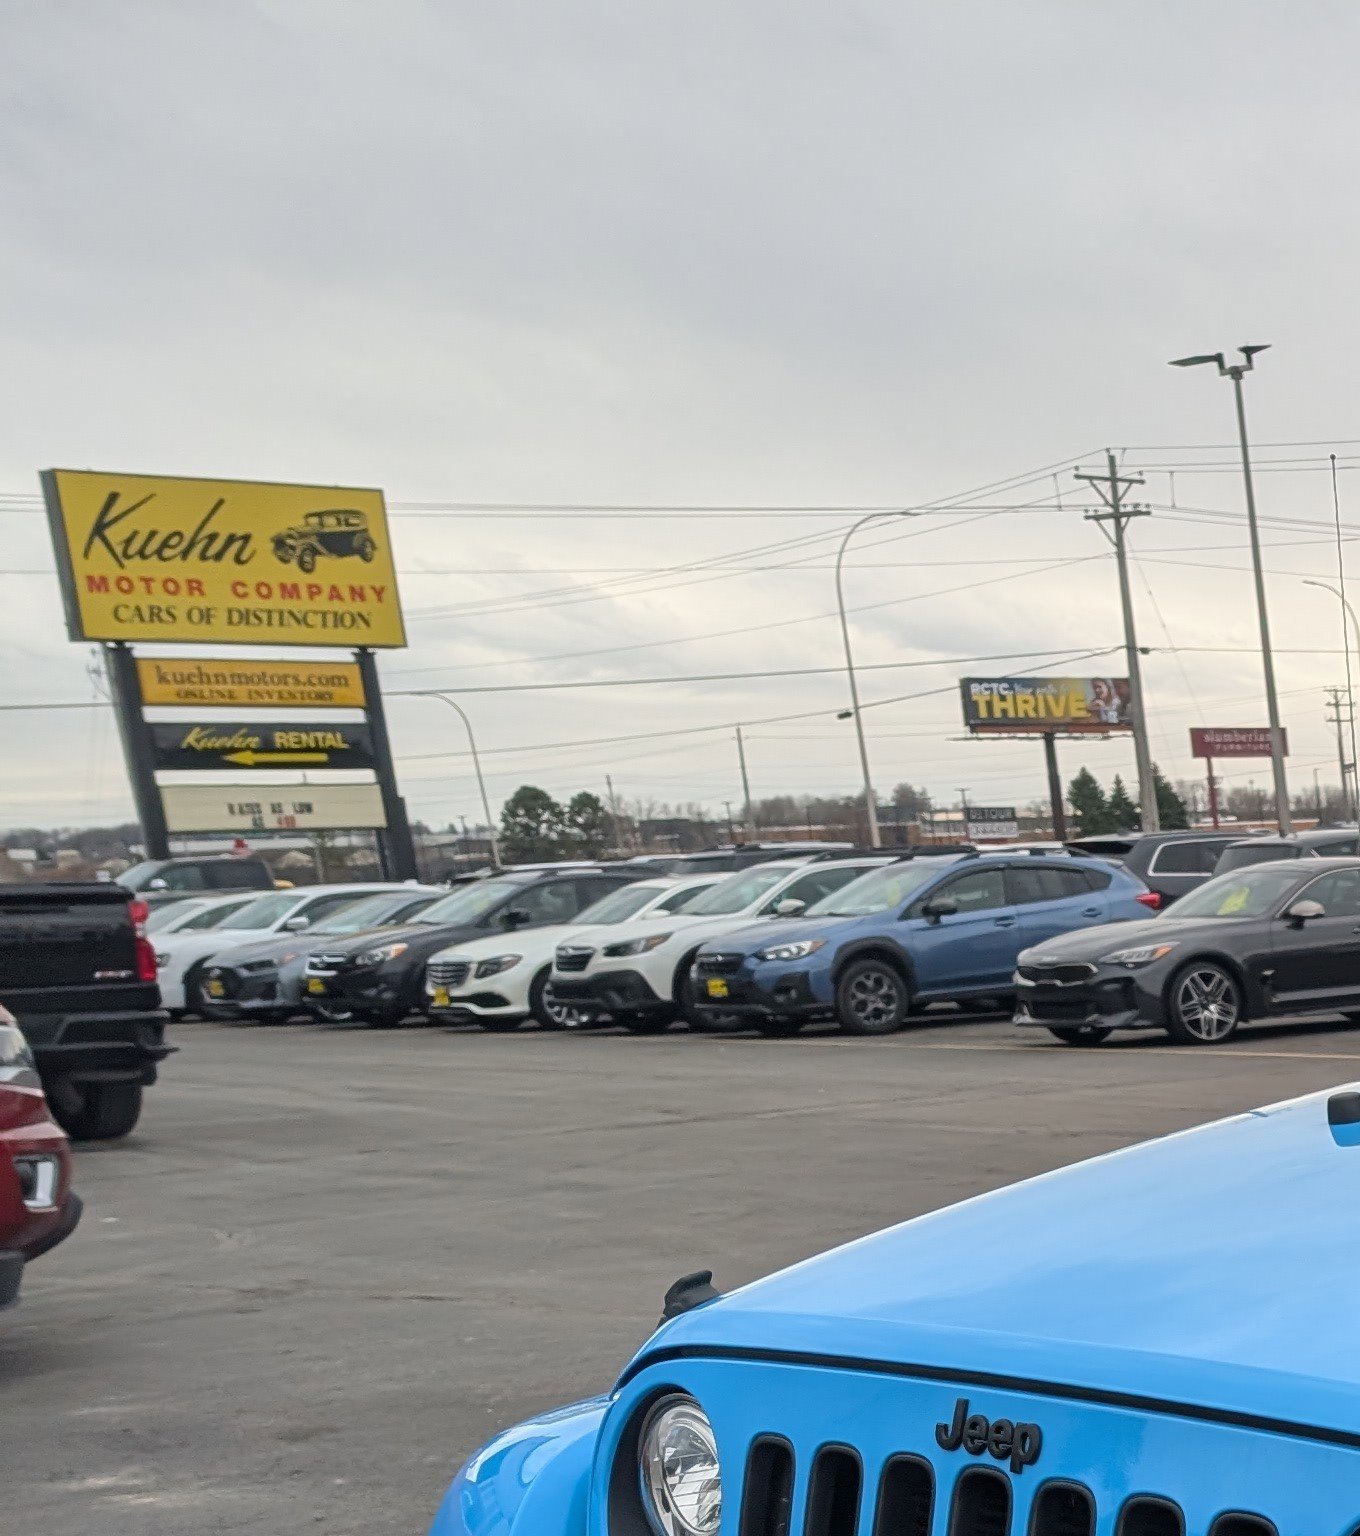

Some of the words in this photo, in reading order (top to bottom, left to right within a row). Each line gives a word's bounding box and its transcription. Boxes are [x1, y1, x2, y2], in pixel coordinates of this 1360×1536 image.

[83, 491, 256, 569] Kuehn
[85, 574, 206, 597] MOTOR
[231, 581, 387, 604] COMPANY
[113, 604, 177, 624] CARS
[187, 607, 217, 626] OF
[226, 607, 372, 630] DISTINCTION
[155, 664, 349, 688] kuehnmotors.com
[273, 731, 350, 750] RENTAL
[935, 1398, 1043, 1475] Jeep
